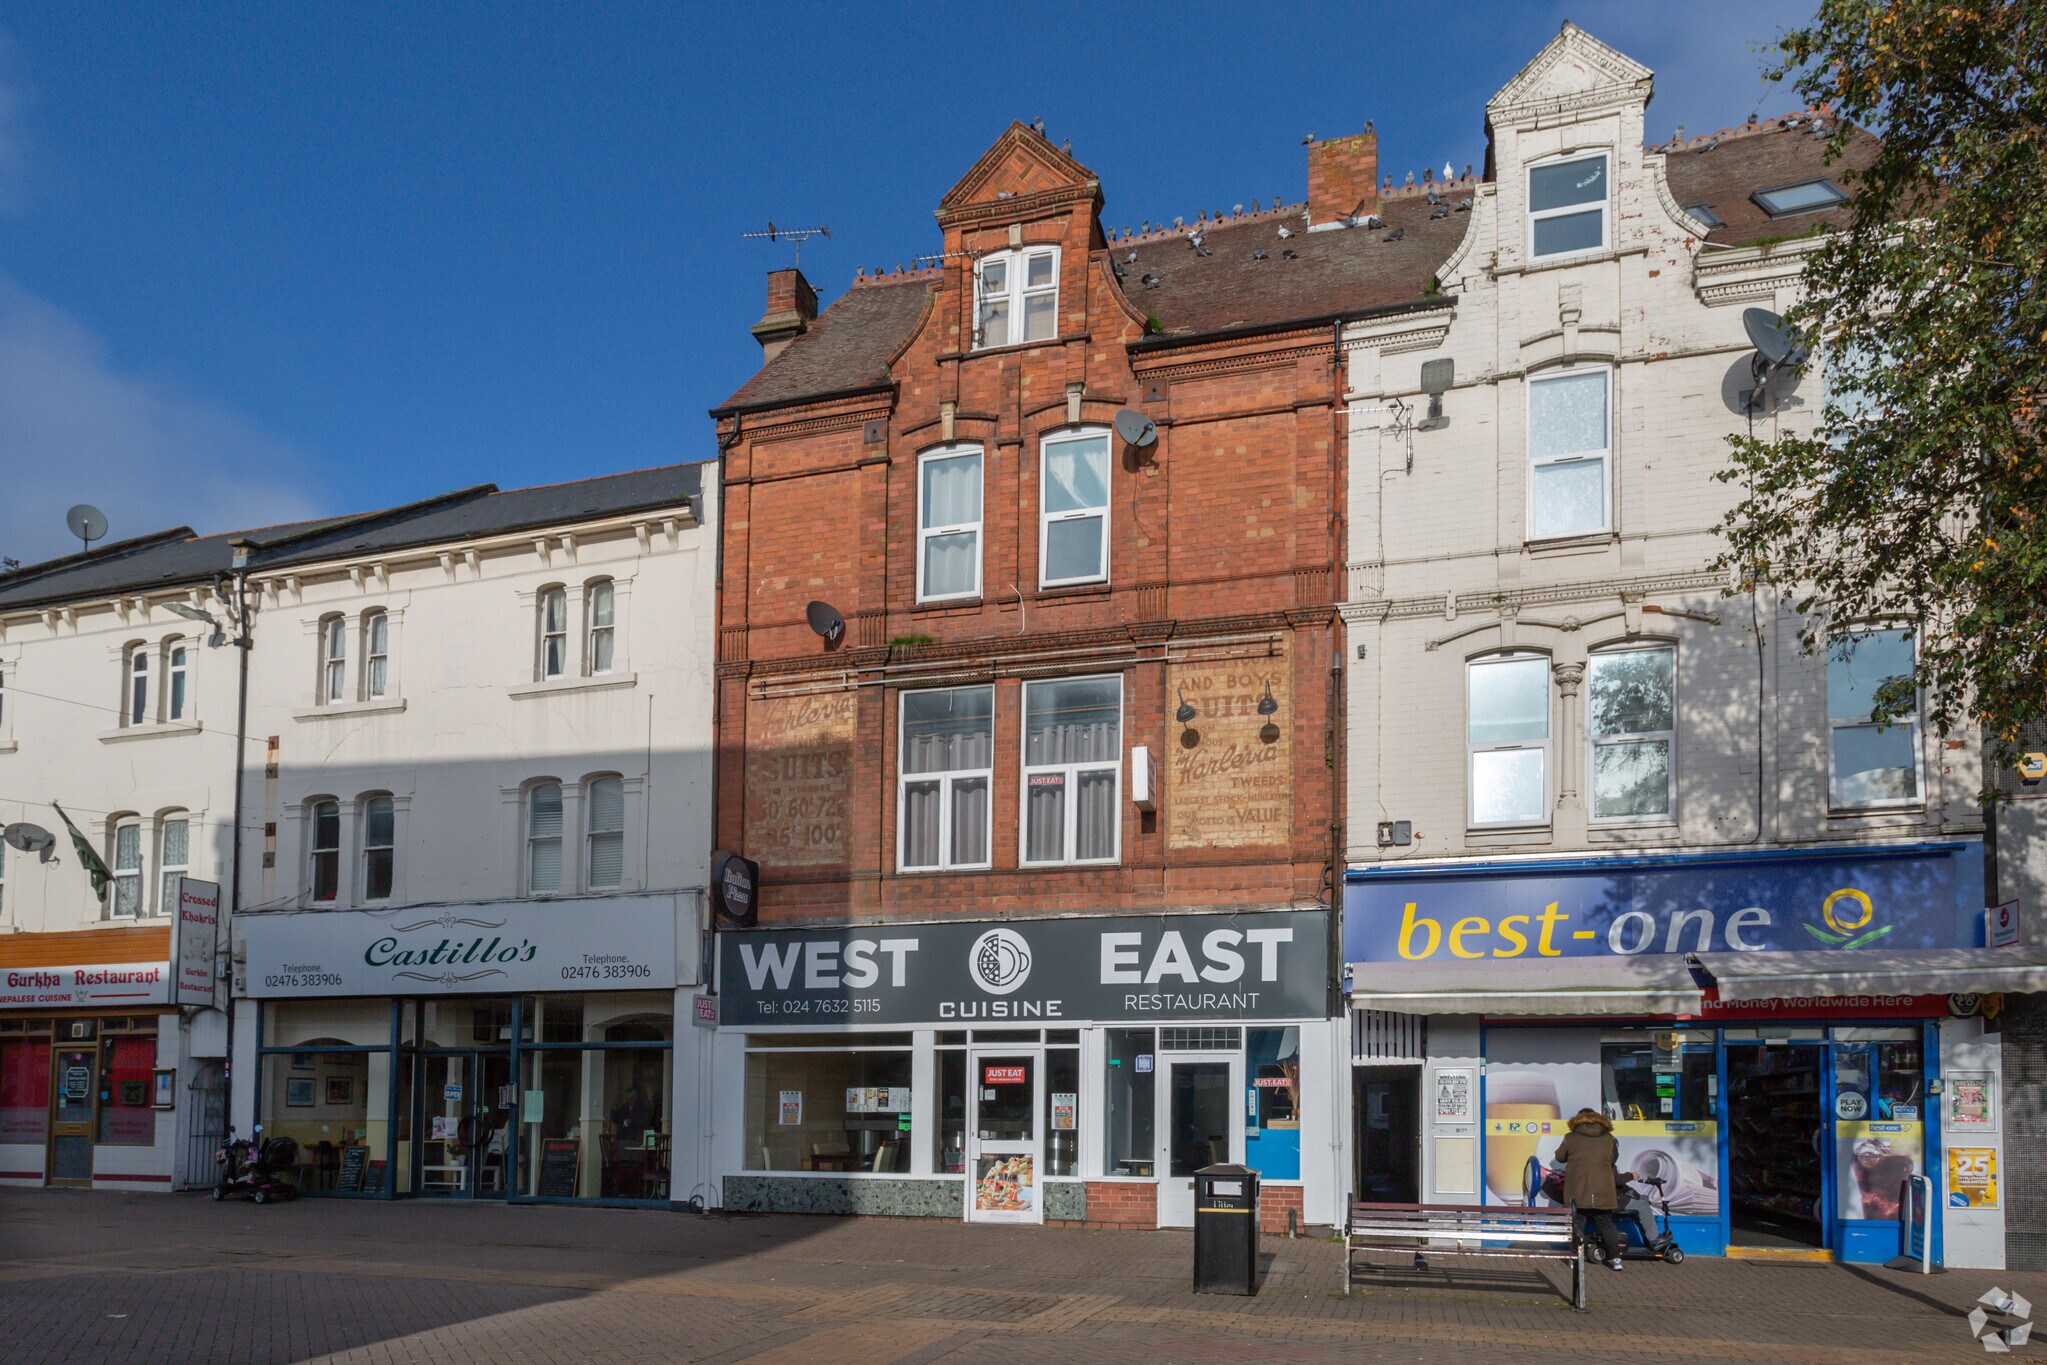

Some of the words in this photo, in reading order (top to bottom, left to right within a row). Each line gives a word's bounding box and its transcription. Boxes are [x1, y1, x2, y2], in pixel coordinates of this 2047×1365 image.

[1180, 676, 1213, 691] AND
[1227, 671, 1282, 689] BOYS
[1231, 774, 1286, 789] TWEEDS
[1177, 811, 1197, 819] OUR
[1235, 807, 1283, 825] VALUE
[724, 867, 751, 890] Italian
[182, 892, 216, 907] Crossed
[182, 910, 216, 925] Khukris
[1396, 900, 1772, 961] best-one
[364, 936, 538, 967] Castillo's
[1100, 927, 1294, 984] EAST
[582, 954, 630, 965] Telephone.
[738, 938, 919, 991] WEST
[185, 967, 208, 977] Gurkha
[282, 963, 323, 975] Telephone.
[561, 965, 600, 979] 02476
[603, 964, 651, 978] 383906
[7, 971, 61, 989] Gurkha
[74, 967, 160, 985] Restaurant
[264, 974, 299, 988] 02476
[300, 973, 343, 987] 383906
[179, 981, 213, 993] Restaurant
[38, 994, 72, 1002] CUISINE
[696, 999, 712, 1009] JUST
[1125, 993, 1260, 1010] RESTAURANT
[1782, 995, 1869, 1008] Worldwide
[1873, 995, 1914, 1007] Here
[700, 1009, 711, 1018] EAT
[757, 1000, 778, 1013] Tel:
[782, 999, 809, 1014] 024
[815, 999, 849, 1013] 7632
[853, 998, 881, 1012] 5115
[939, 1000, 1062, 1018] CUISINE
[987, 1069, 1007, 1077] JUST
[1007, 1069, 1023, 1077] EAT
[1956, 1156, 1990, 1178] 25
